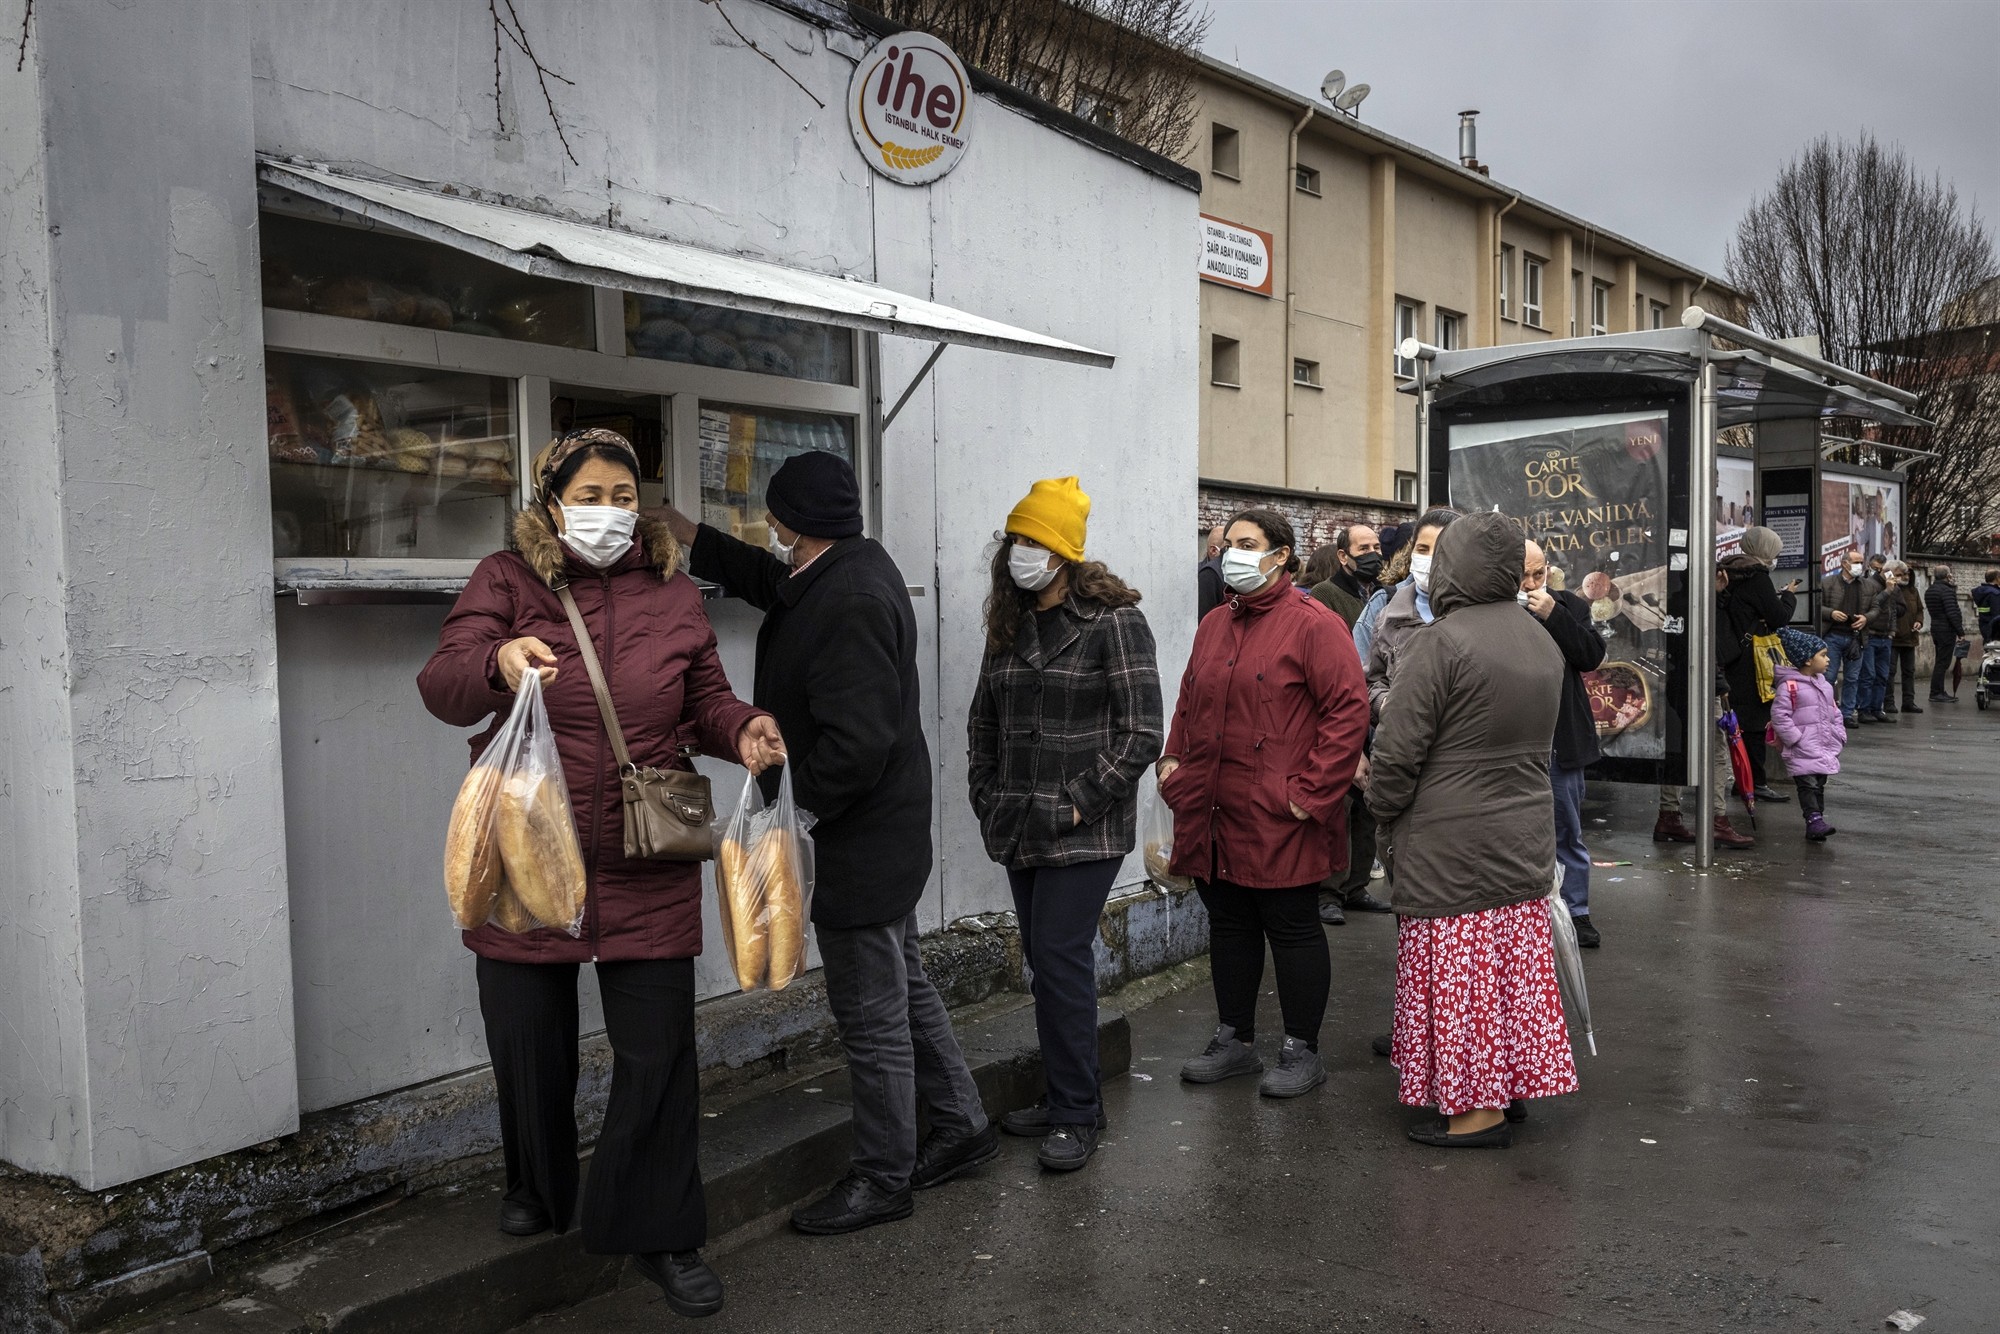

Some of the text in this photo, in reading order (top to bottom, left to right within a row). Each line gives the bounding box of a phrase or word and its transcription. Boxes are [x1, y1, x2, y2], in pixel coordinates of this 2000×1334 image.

[877, 45, 956, 129] ihe
[885, 108, 919, 134] İSTANBUL
[920, 125, 940, 141] HALK
[1207, 224, 1226, 240] İSTANBUL
[1229, 233, 1252, 247] SULTANGAZİ
[1207, 241, 1219, 255] ŞAİR
[1220, 246, 1234, 258] ABAY
[1207, 259, 1248, 280] ANADOLU LİSESİ
[1629, 432, 1657, 447] YENİ
[1524, 455, 1581, 478] CARTE
[1526, 473, 1599, 499] D'OR
[1560, 501, 1655, 527] VANİLYA,
[1589, 526, 1654, 551] ÇİLEK
